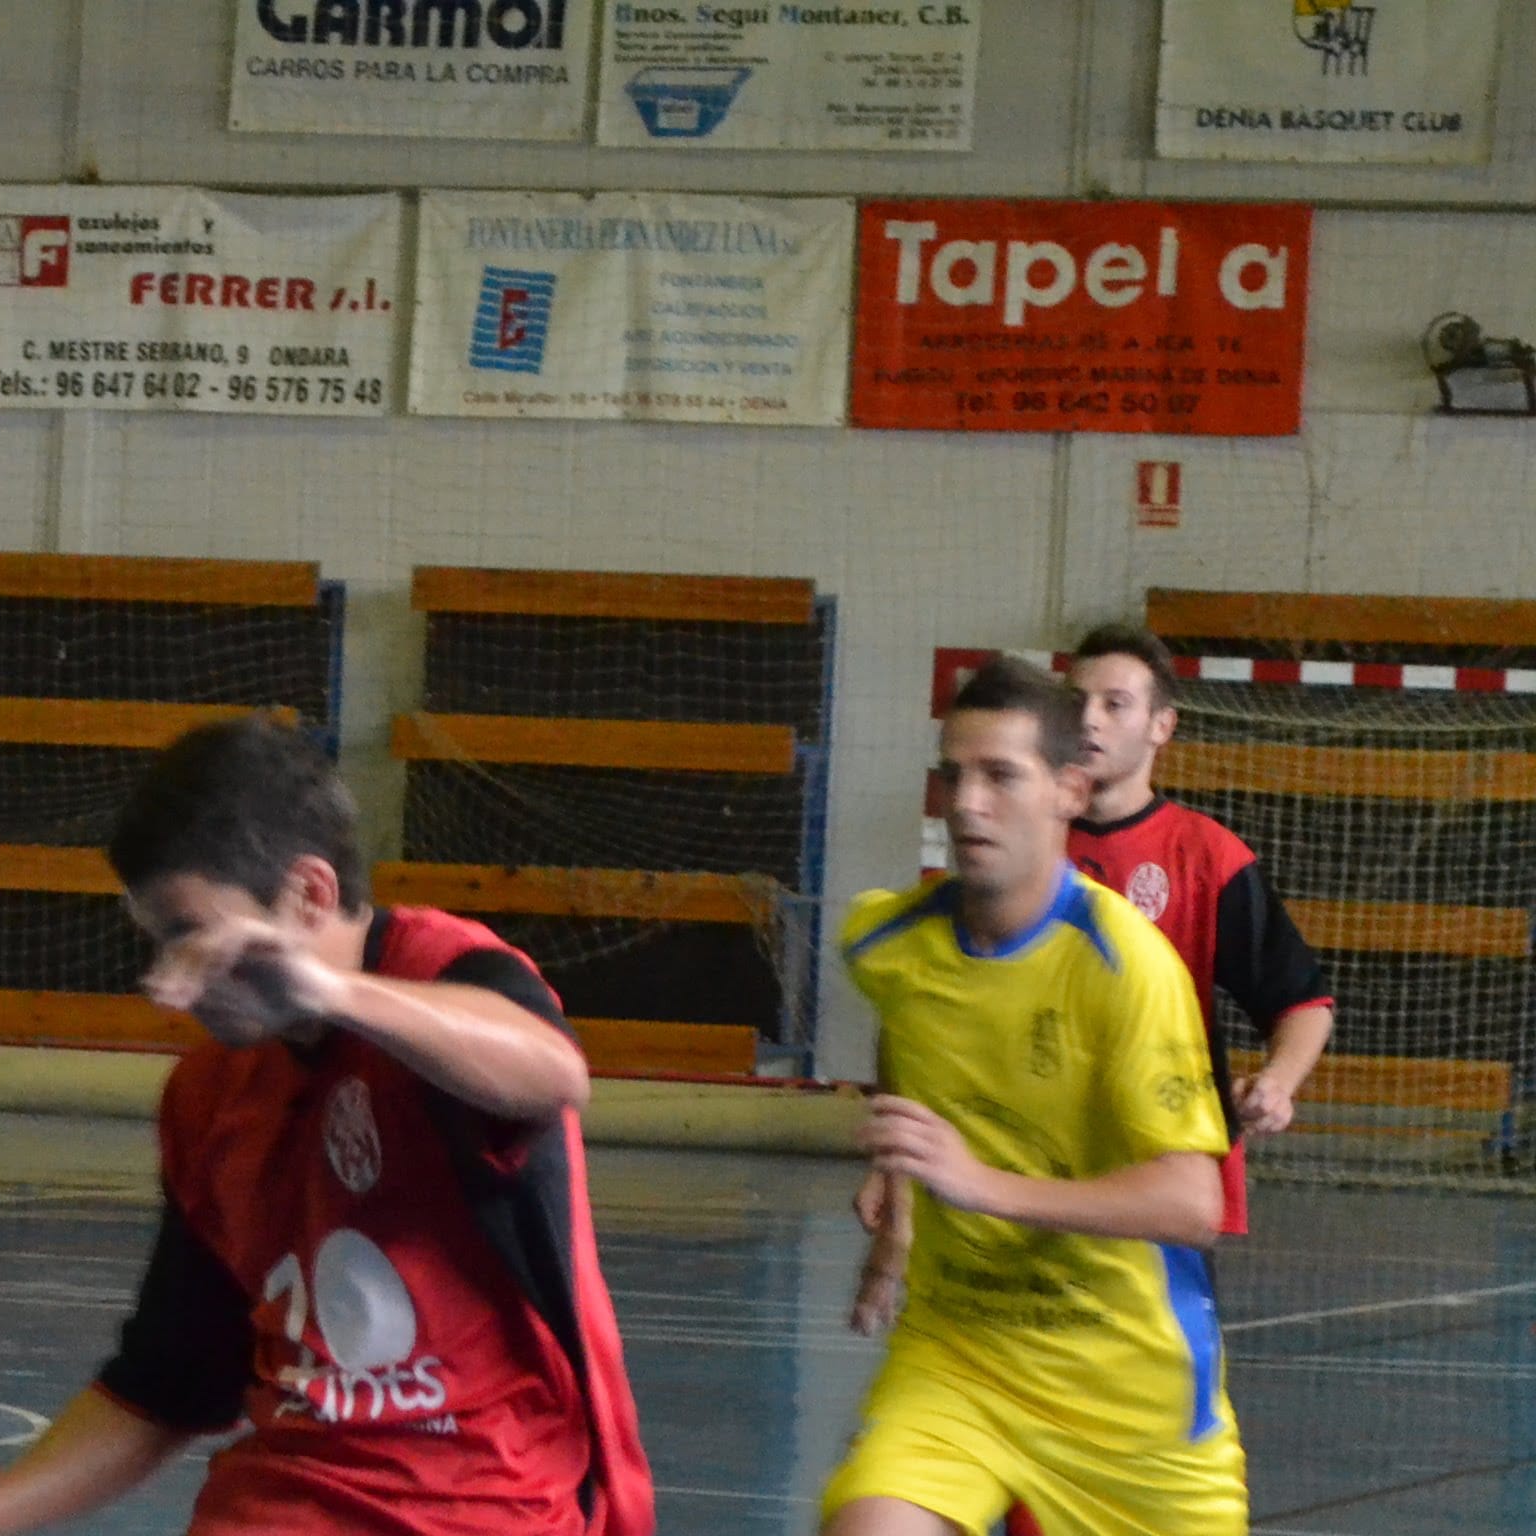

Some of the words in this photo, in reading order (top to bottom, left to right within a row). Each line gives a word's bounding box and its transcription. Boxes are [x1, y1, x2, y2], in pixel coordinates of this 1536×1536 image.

[246, 56, 345, 80] CARROS
[355, 60, 416, 81] PARA
[426, 63, 457, 83] LA
[466, 63, 569, 84] COMPRA
[1403, 110, 1462, 132] CLUB
[78, 212, 160, 233] azulejos
[76, 237, 215, 256] saneamientos
[129, 272, 316, 311] FERRER
[23, 341, 42, 361] C.
[49, 341, 129, 361] MESTRE
[137, 342, 229, 367] SERRANO,
[237, 344, 250, 364] 9
[269, 346, 350, 367] ONDARA
[56, 370, 84, 397] 96
[92, 371, 135, 397] 647
[228, 374, 257, 401] 96
[266, 376, 309, 402] 576
[319, 377, 345, 403] 75
[354, 377, 381, 404] 48
